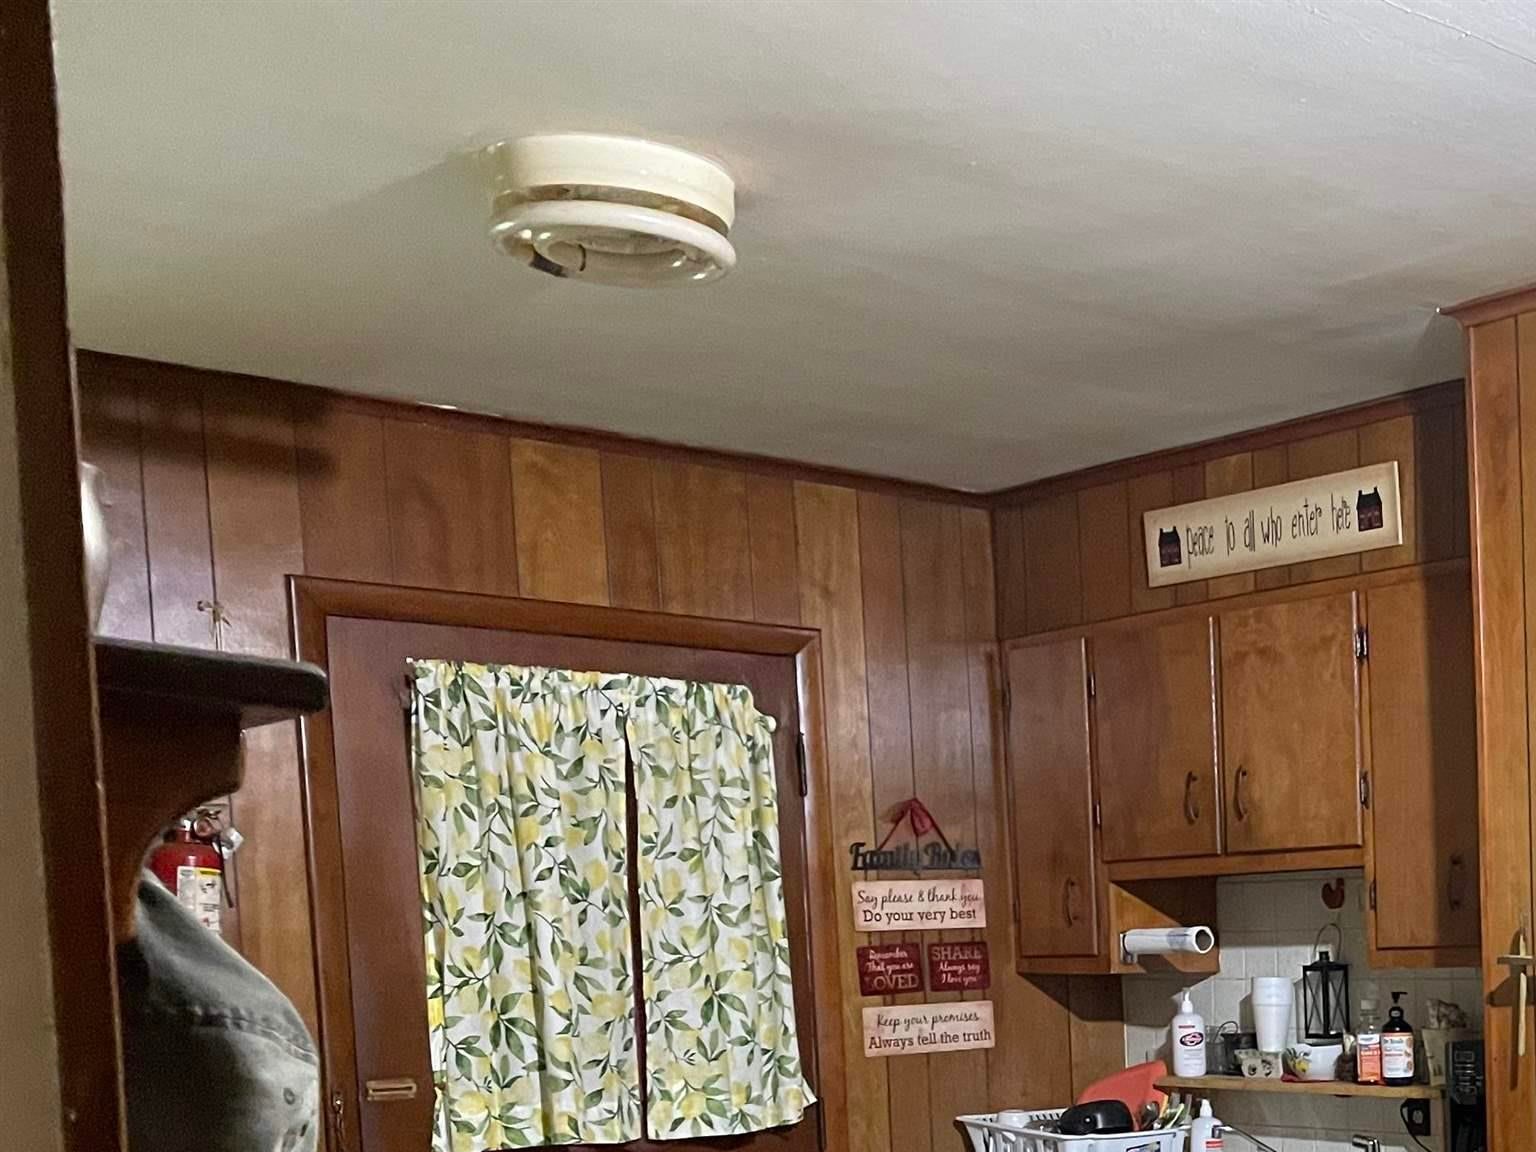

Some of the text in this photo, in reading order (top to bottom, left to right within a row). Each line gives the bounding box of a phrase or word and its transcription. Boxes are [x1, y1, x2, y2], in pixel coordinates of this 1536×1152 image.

[1186, 492, 1352, 569] peace to all who enter here
[857, 886, 980, 910] Say please & thank you
[863, 907, 977, 925] Do your very best
[932, 946, 984, 960] SHARE
[886, 964, 901, 976] you
[963, 975, 978, 987] you
[876, 1012, 980, 1033] Keep your promises
[868, 1028, 991, 1051] Always tell the truth
